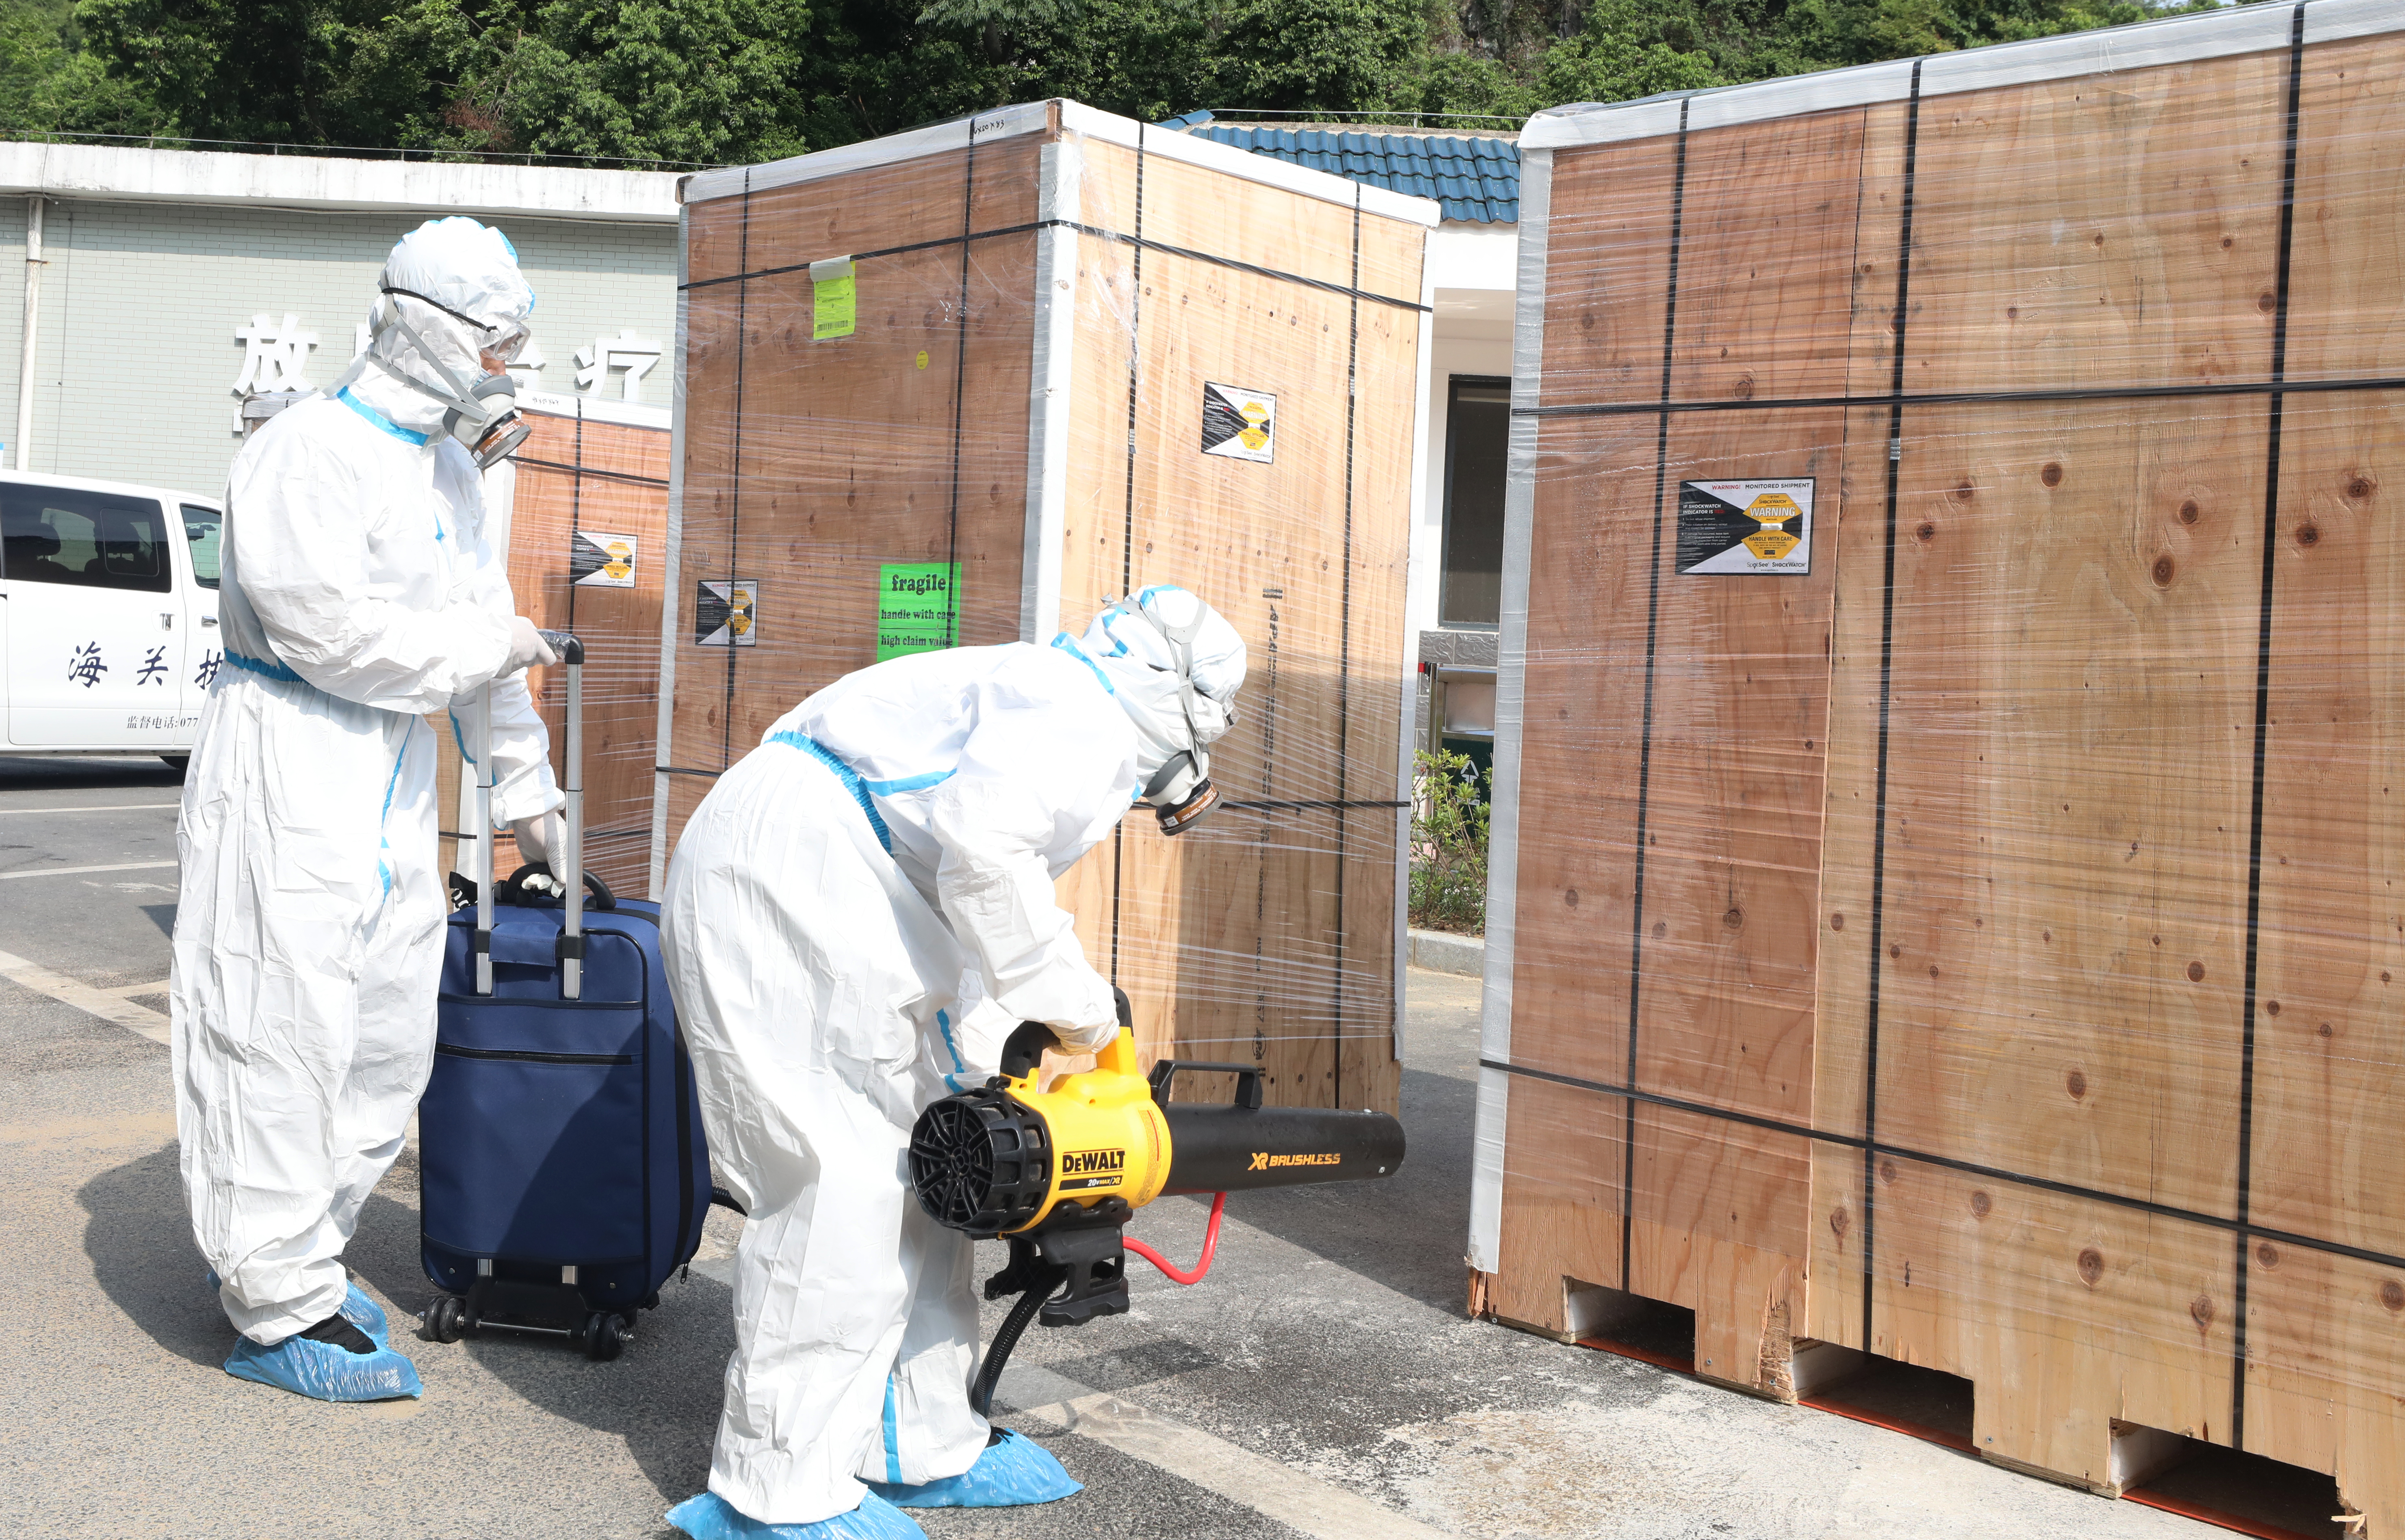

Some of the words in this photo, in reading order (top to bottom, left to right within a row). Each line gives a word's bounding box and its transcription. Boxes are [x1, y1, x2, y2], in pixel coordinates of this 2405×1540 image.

[1243, 410, 1266, 420] WARNING
[1750, 507, 1796, 517] WARNING
[892, 574, 946, 595] fragile
[881, 609, 911, 619] handle
[913, 609, 934, 619] with
[881, 635, 900, 648] high
[902, 635, 926, 646] claim
[1248, 1152, 1268, 1170] XR
[1269, 1153, 1341, 1166] BRUSHLESS
